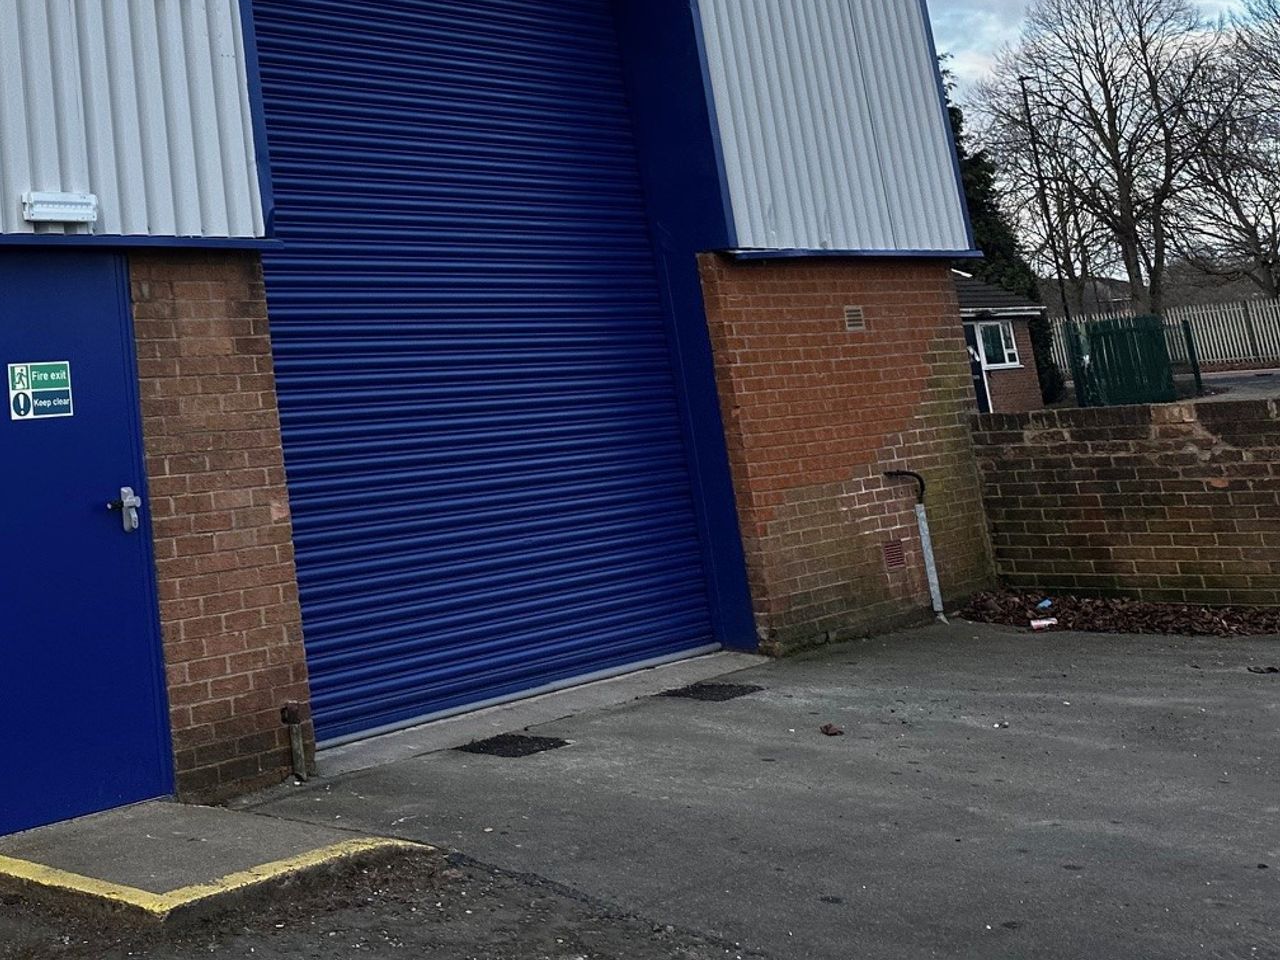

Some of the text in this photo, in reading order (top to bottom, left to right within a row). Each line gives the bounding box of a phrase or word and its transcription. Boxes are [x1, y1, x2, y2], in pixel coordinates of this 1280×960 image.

[31, 369, 67, 381] Fire exit
[33, 397, 70, 408] Keep clear
